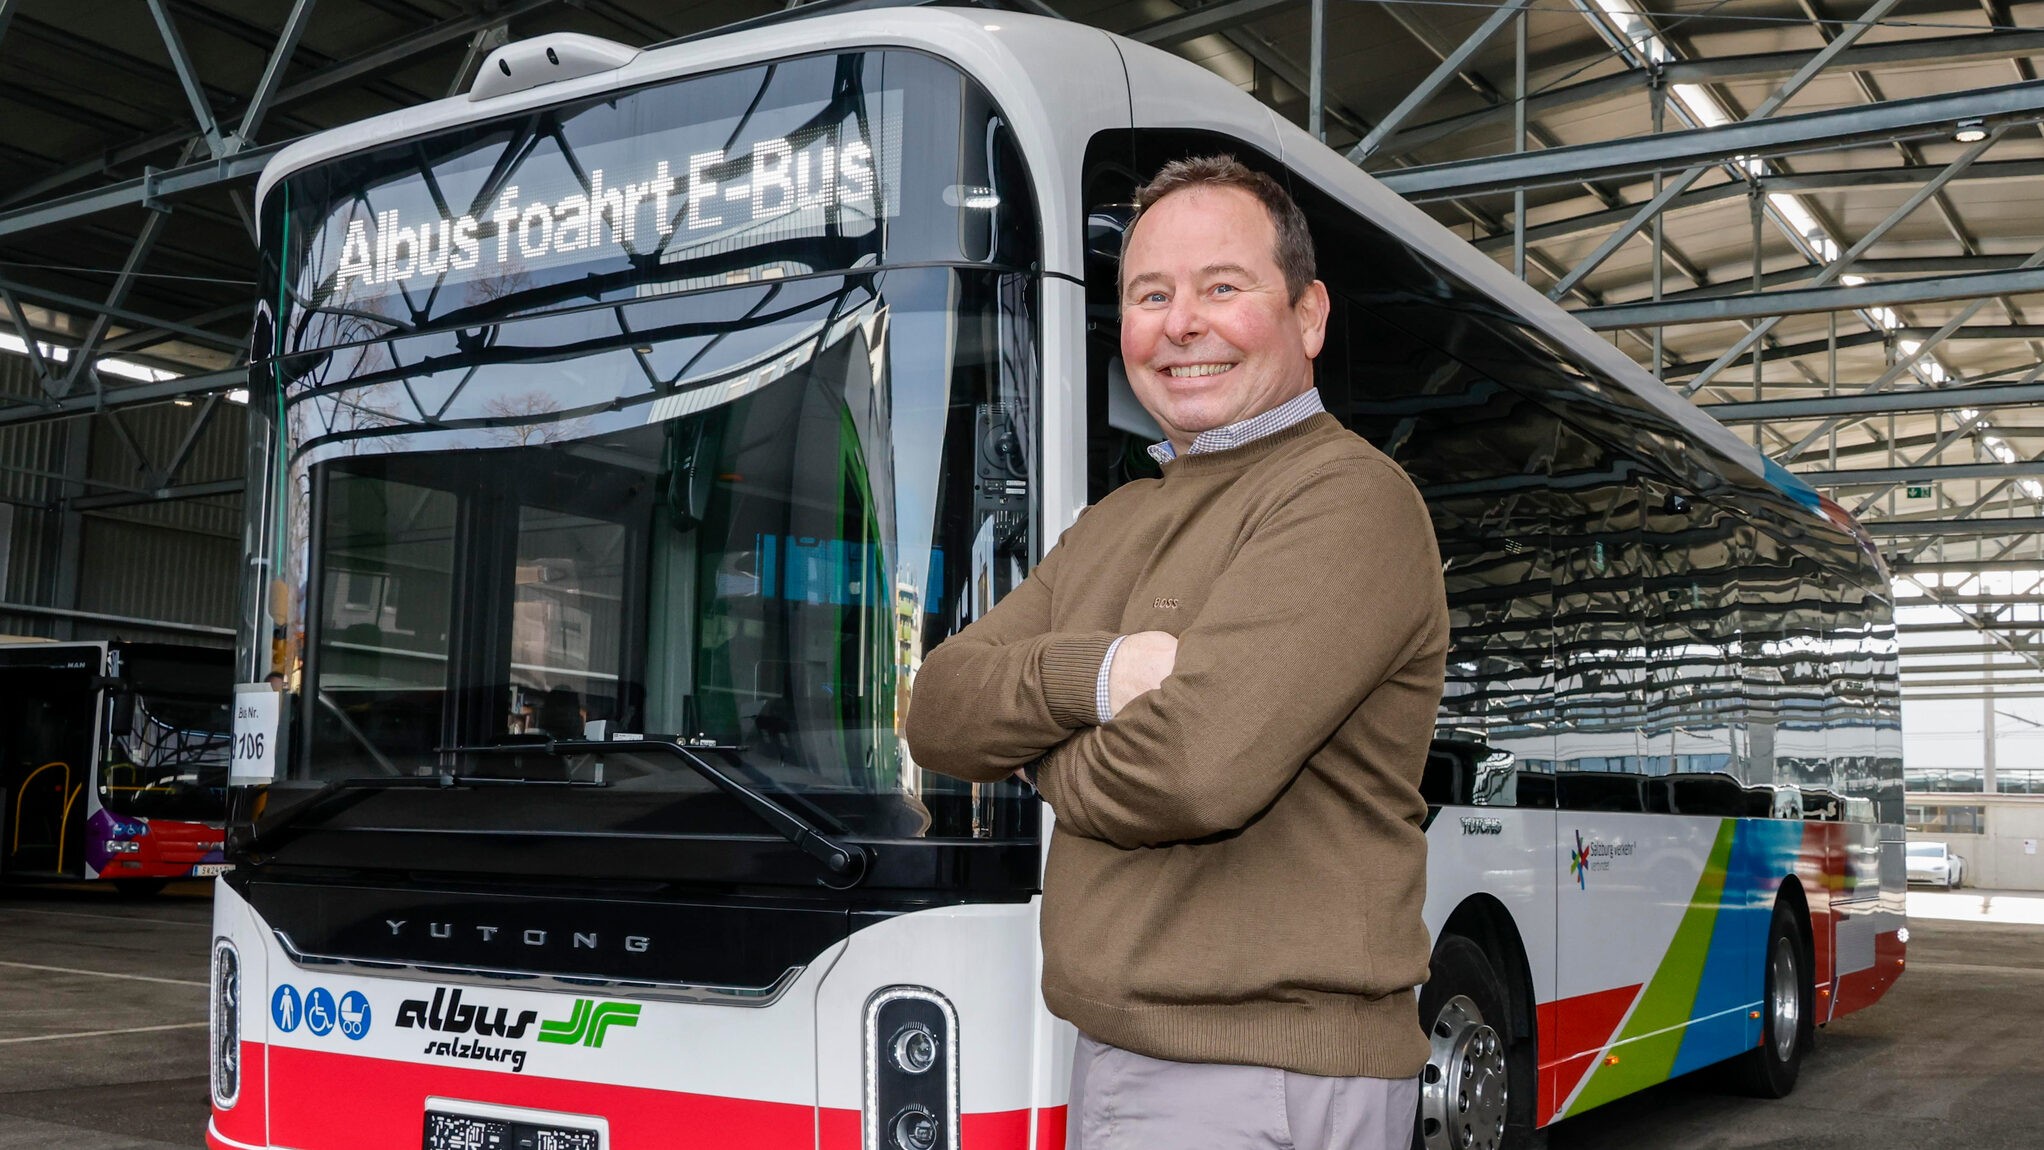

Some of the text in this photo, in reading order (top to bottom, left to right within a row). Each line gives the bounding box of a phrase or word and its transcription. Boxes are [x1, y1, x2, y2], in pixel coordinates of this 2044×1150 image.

[334, 137, 874, 291] Albus foahrt E-Bus
[1152, 597, 1179, 609] BOSS
[247, 706, 259, 719] Nr.
[1590, 841, 1614, 859] Salzburg
[386, 919, 650, 953] YUTONG
[395, 987, 538, 1039] albus
[424, 1036, 527, 1073] salzburg
